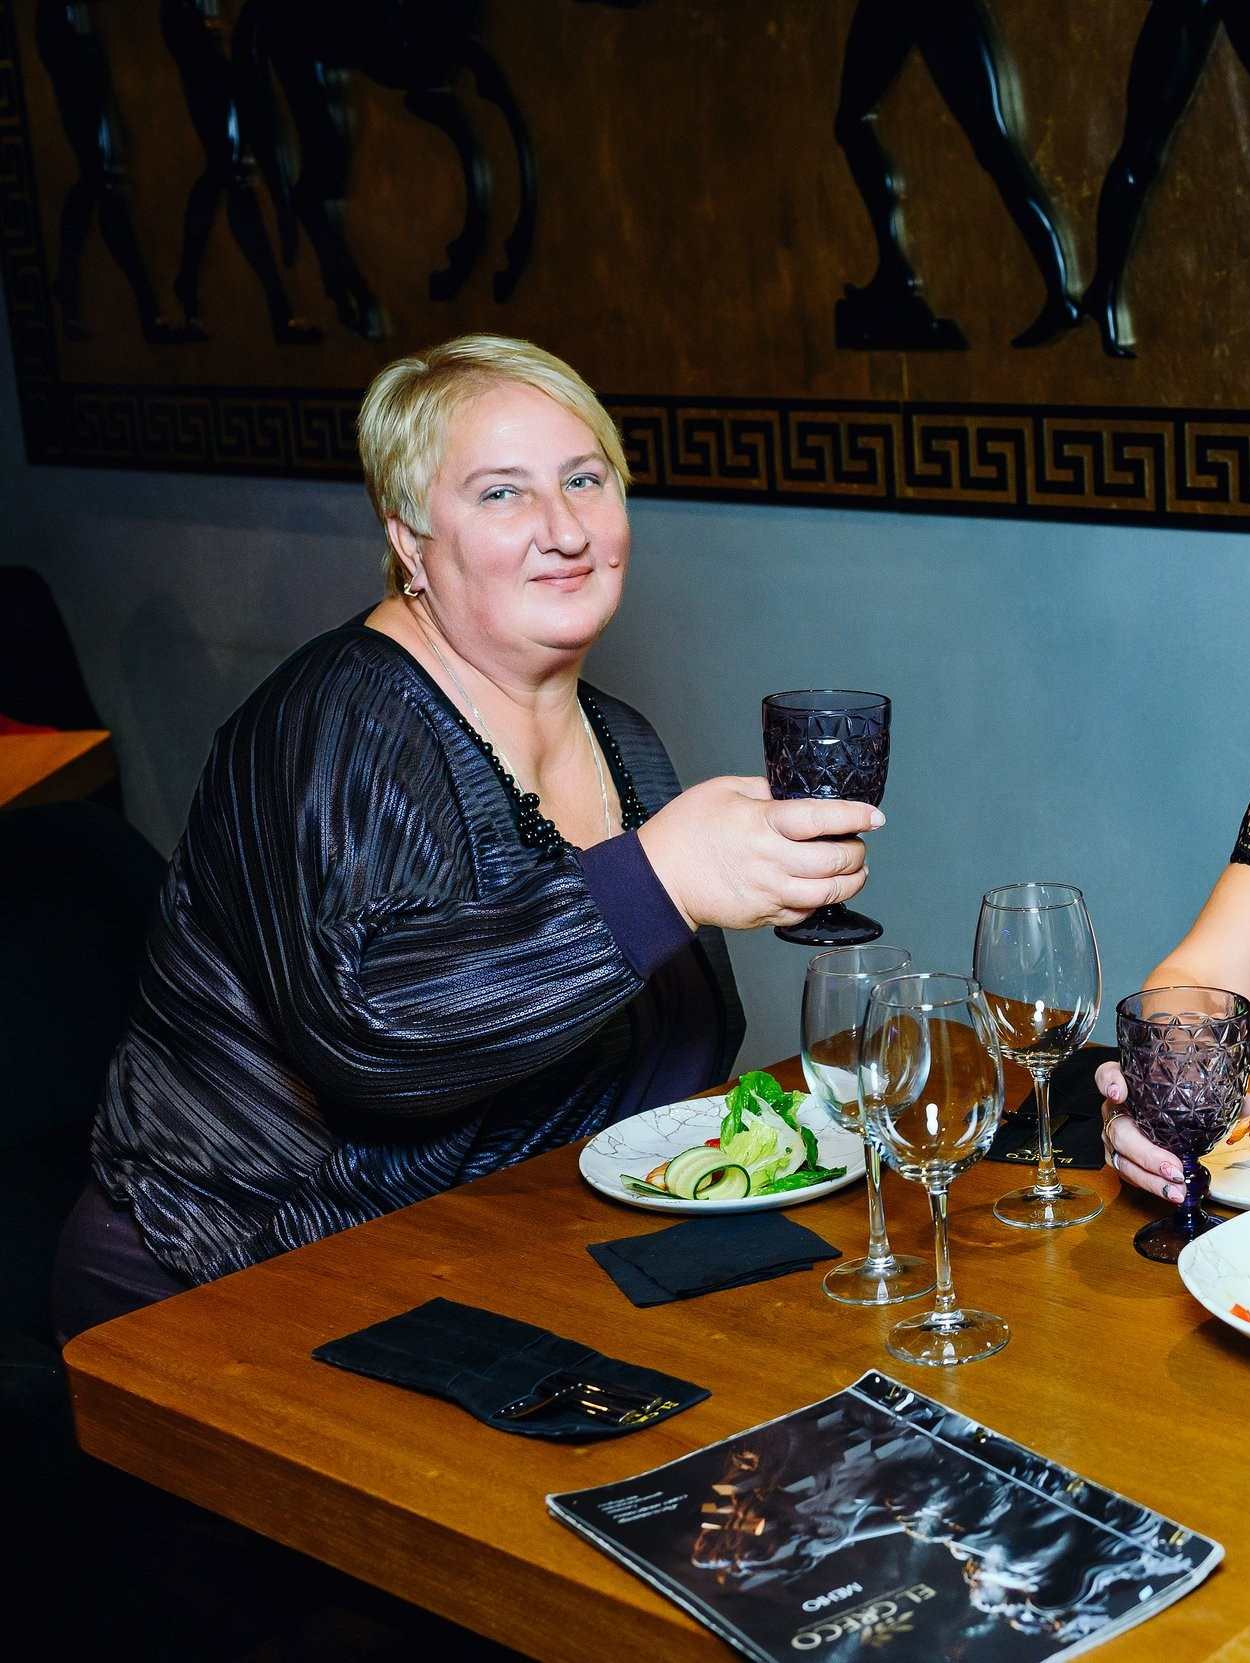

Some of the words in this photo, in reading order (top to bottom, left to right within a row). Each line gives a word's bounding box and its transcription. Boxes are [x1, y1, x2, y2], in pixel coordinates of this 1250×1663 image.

[802, 1581, 864, 1612] МЕНЮ
[894, 1583, 937, 1604] EL
[791, 1600, 898, 1650] GRECO
